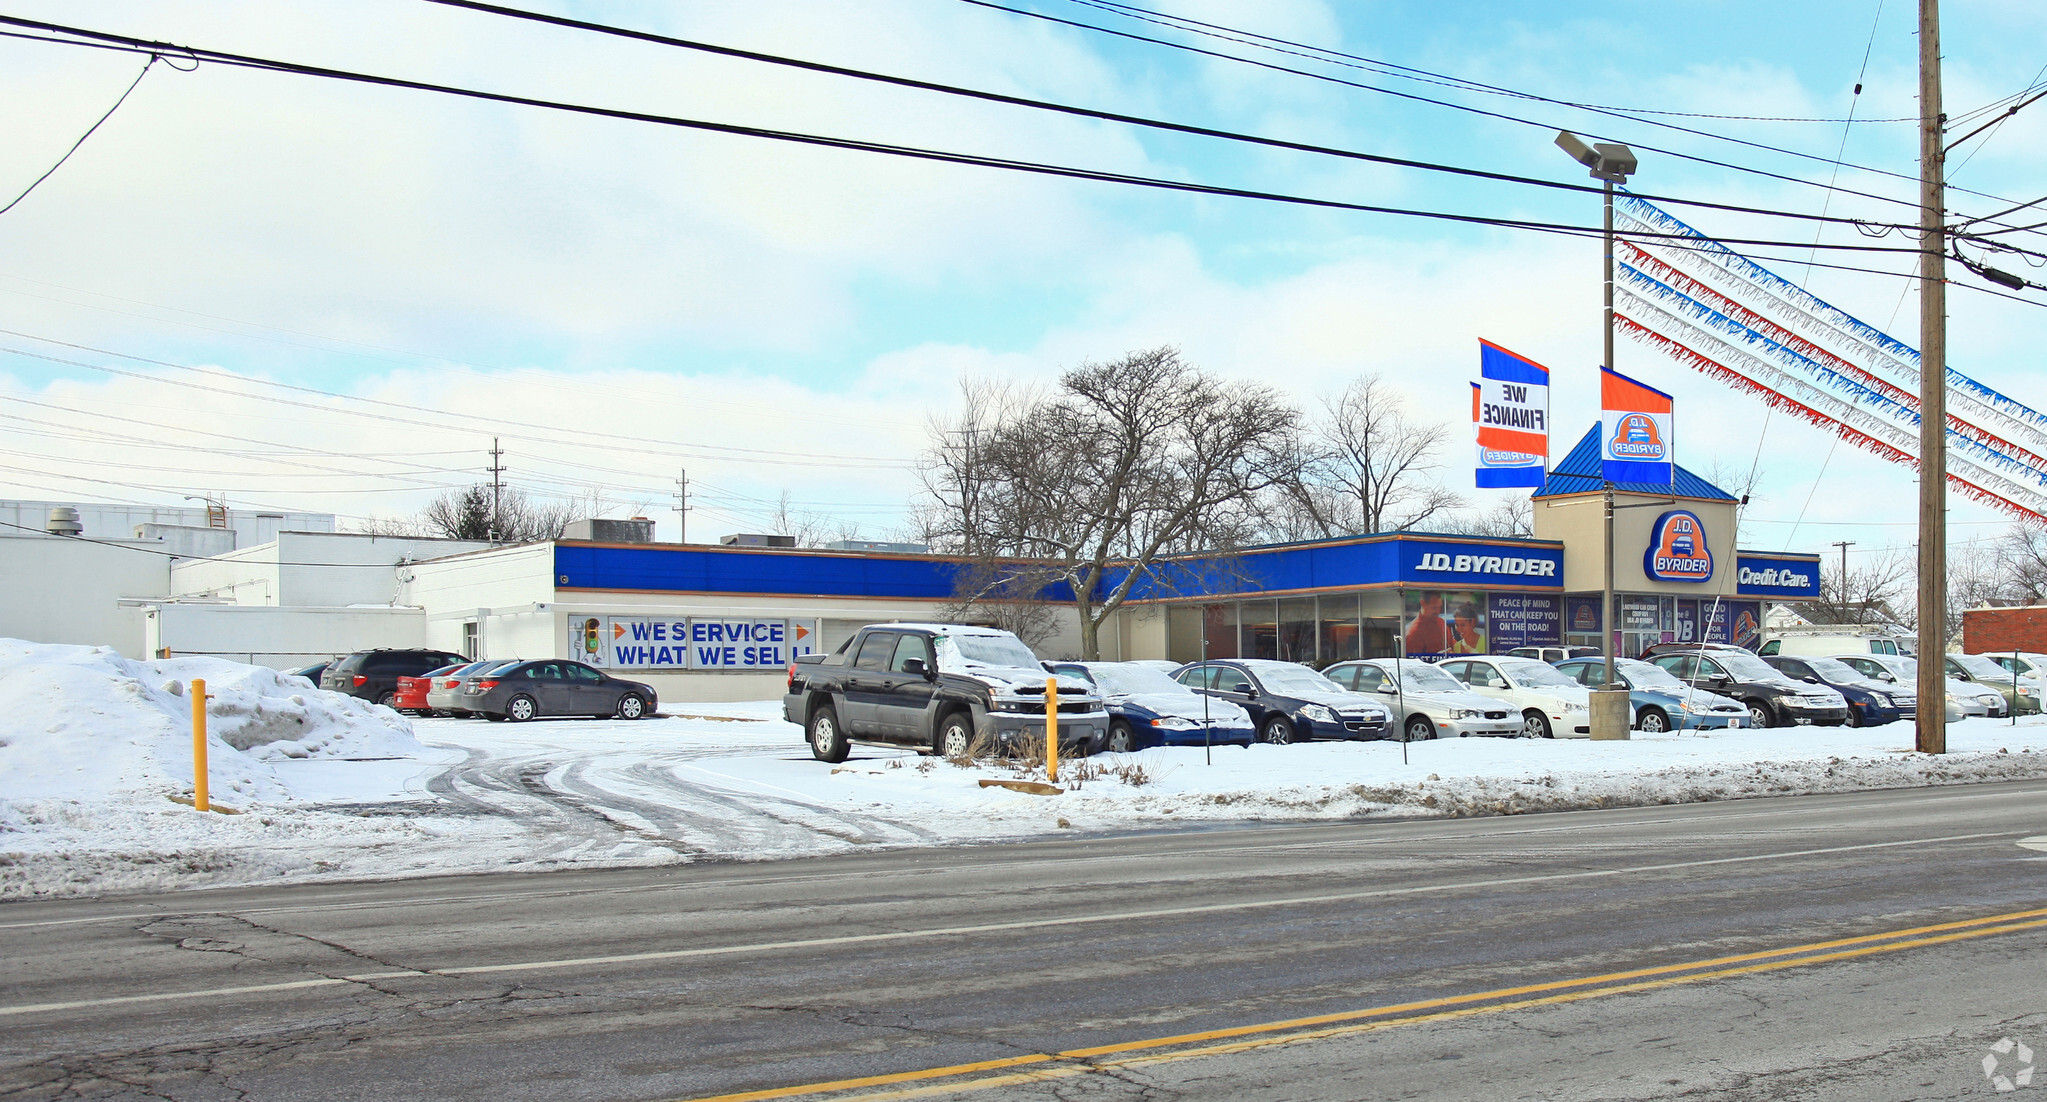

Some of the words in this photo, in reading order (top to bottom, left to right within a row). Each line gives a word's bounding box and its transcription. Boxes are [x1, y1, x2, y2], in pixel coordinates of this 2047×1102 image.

[1673, 519, 1693, 533] J.D.
[1657, 557, 1707, 572] BYRIDER
[1499, 599, 1520, 607] PEACE
[1533, 600, 1550, 608] MIND
[1704, 604, 1726, 613] GOOD
[1491, 611, 1509, 619] THAT
[1510, 611, 1525, 619] CAN
[1544, 612, 1558, 620] YOU
[1705, 614, 1725, 623] CARS
[631, 622, 666, 640] WE
[672, 622, 783, 642] SERVICE
[1512, 623, 1525, 631] THE
[1527, 624, 1549, 632] ROAD!
[616, 646, 686, 664] WHAT
[698, 647, 735, 665] WE
